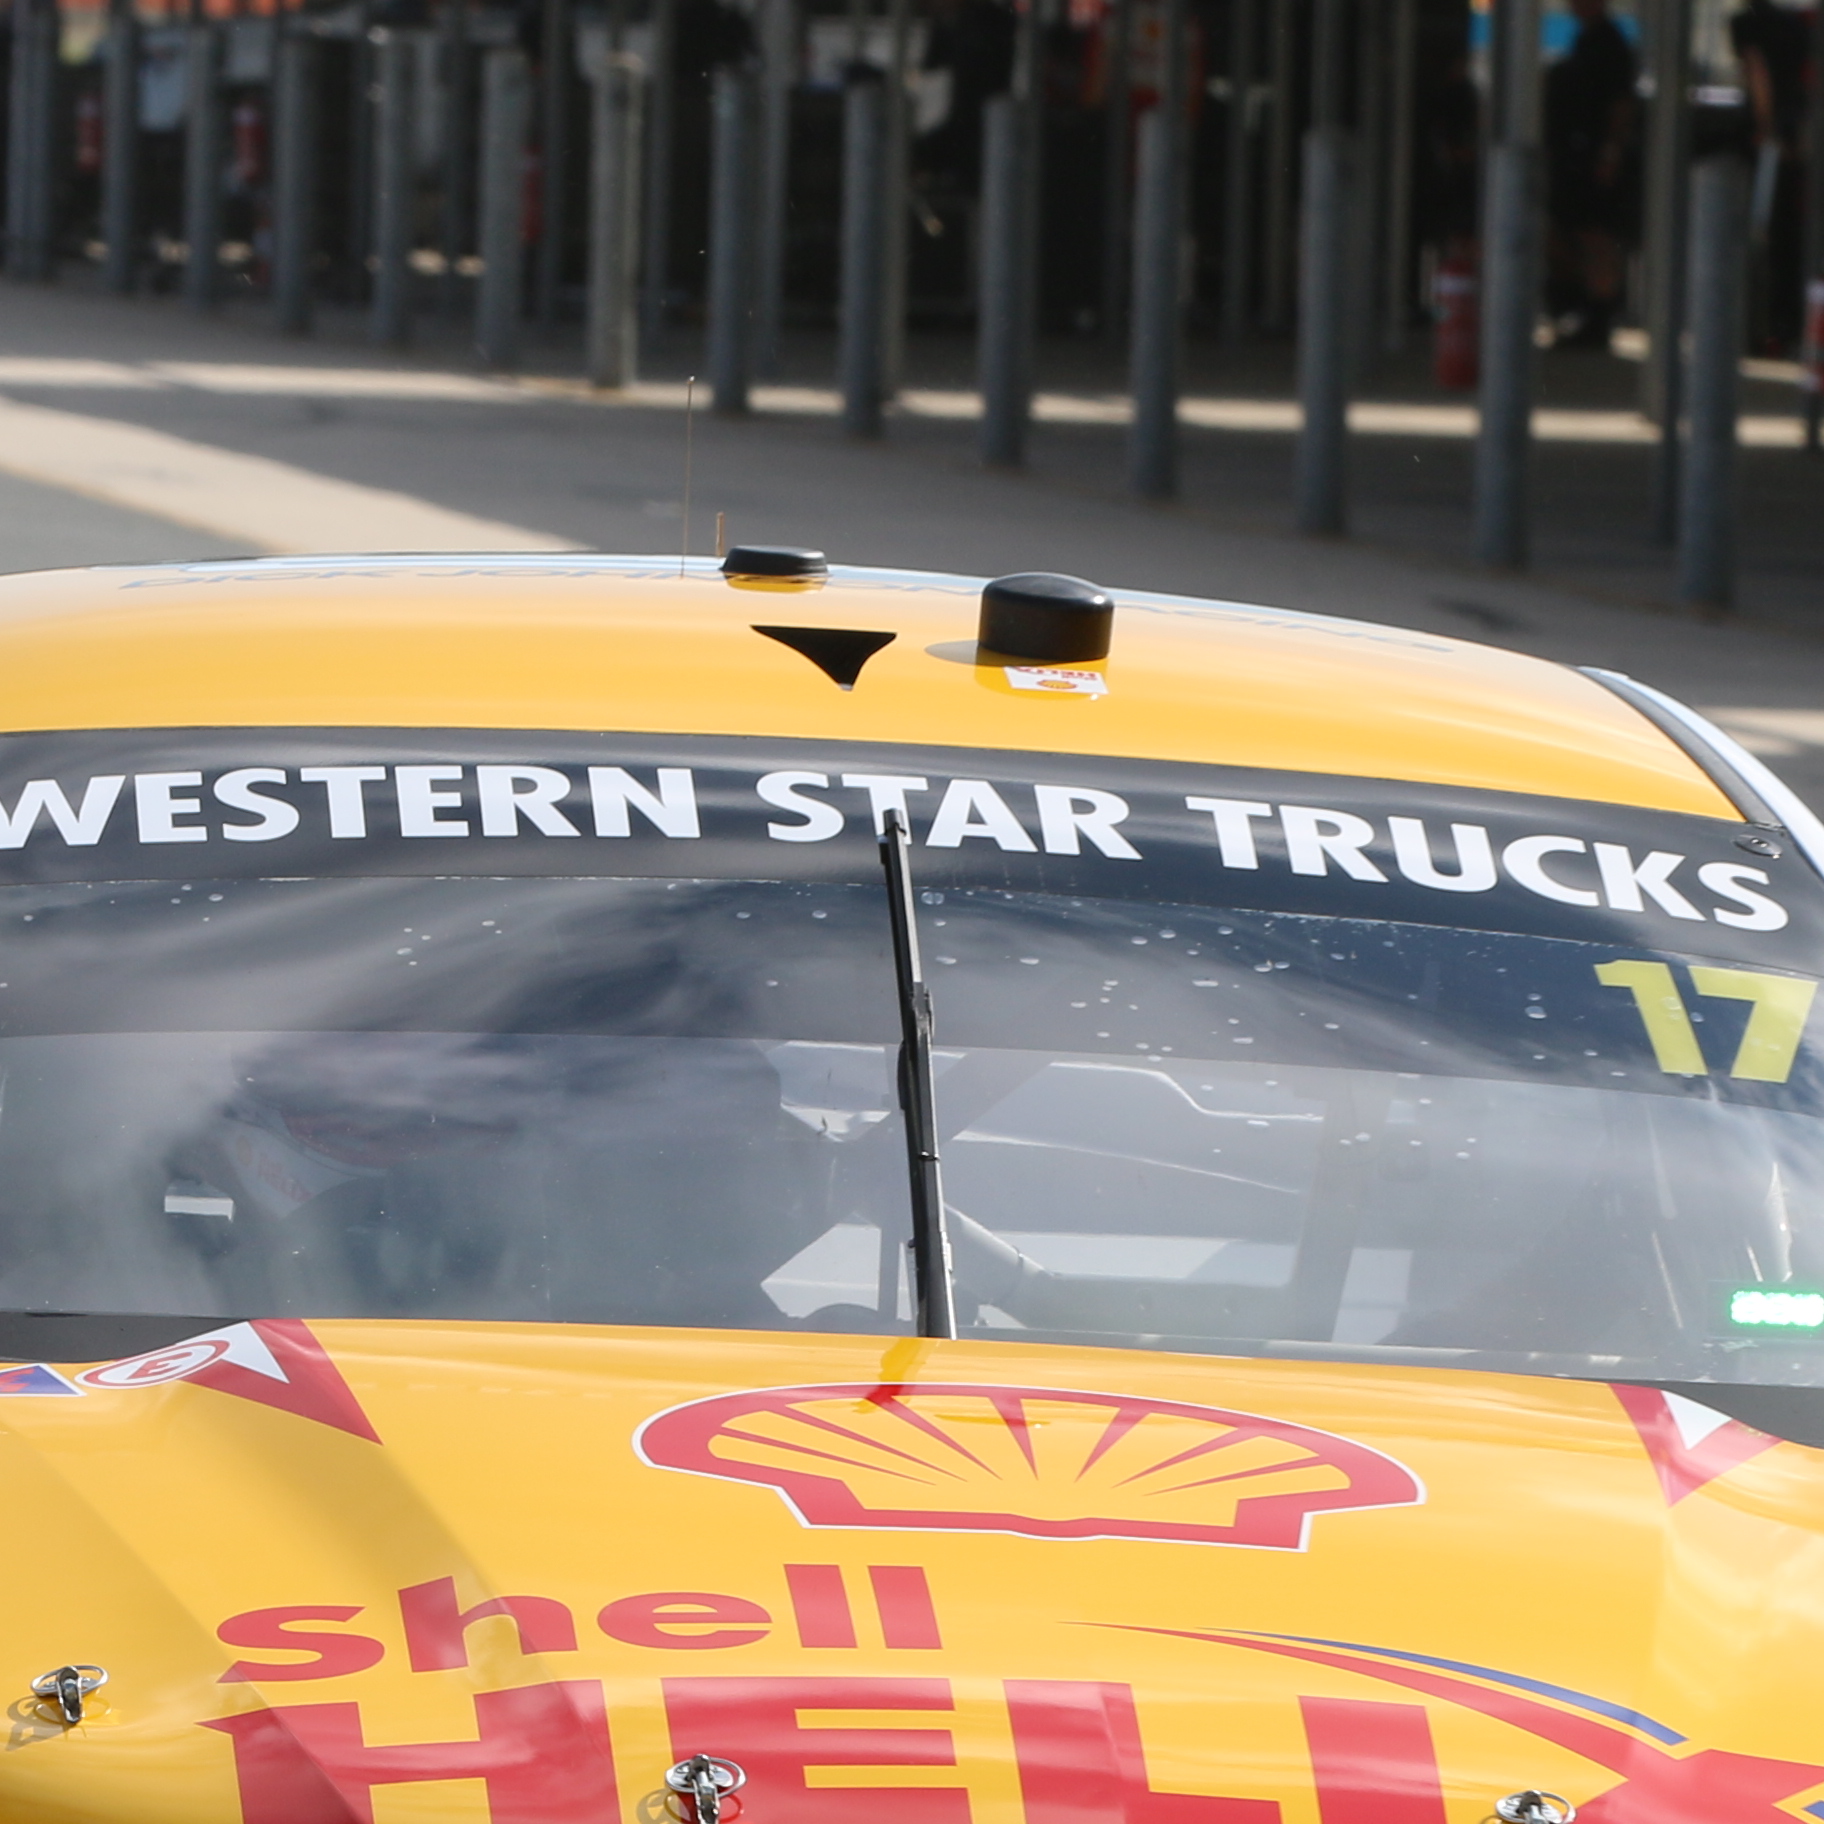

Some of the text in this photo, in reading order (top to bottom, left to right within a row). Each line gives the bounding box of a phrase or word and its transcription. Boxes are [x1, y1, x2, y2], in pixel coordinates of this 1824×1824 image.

[755, 770, 1143, 861] STAR
[1185, 795, 1788, 932] TRUCKS
[1592, 959, 1818, 1084] 17
[214, 1563, 943, 1685] shell
